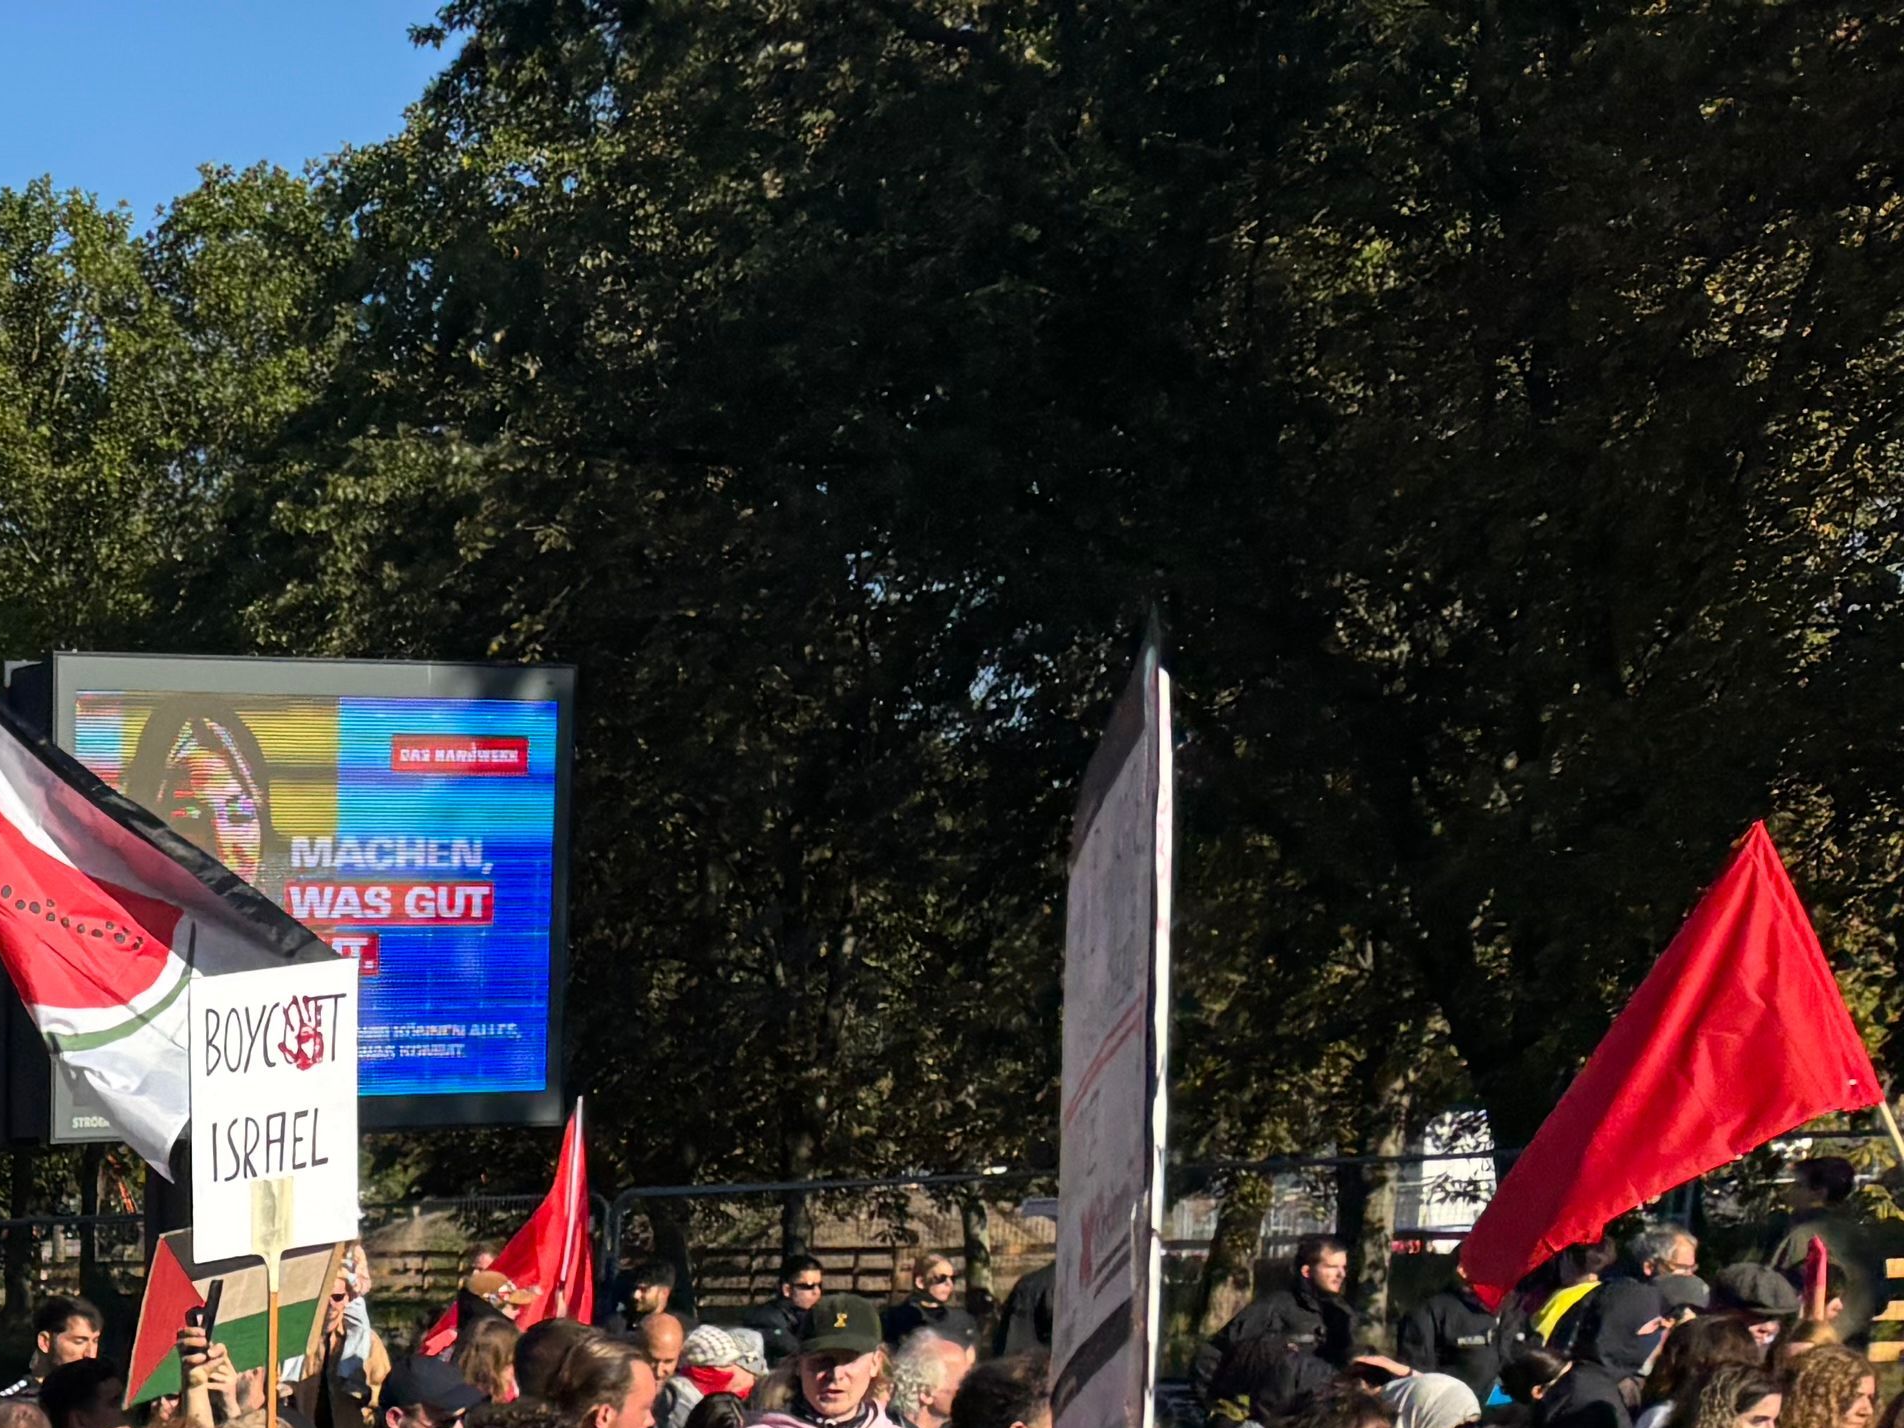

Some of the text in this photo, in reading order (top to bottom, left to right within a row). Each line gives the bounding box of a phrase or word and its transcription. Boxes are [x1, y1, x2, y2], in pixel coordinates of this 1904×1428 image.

[292, 836, 493, 874] MACHEN,
[288, 886, 491, 919] WAS GUT
[212, 1108, 329, 1182] ISRAEL
